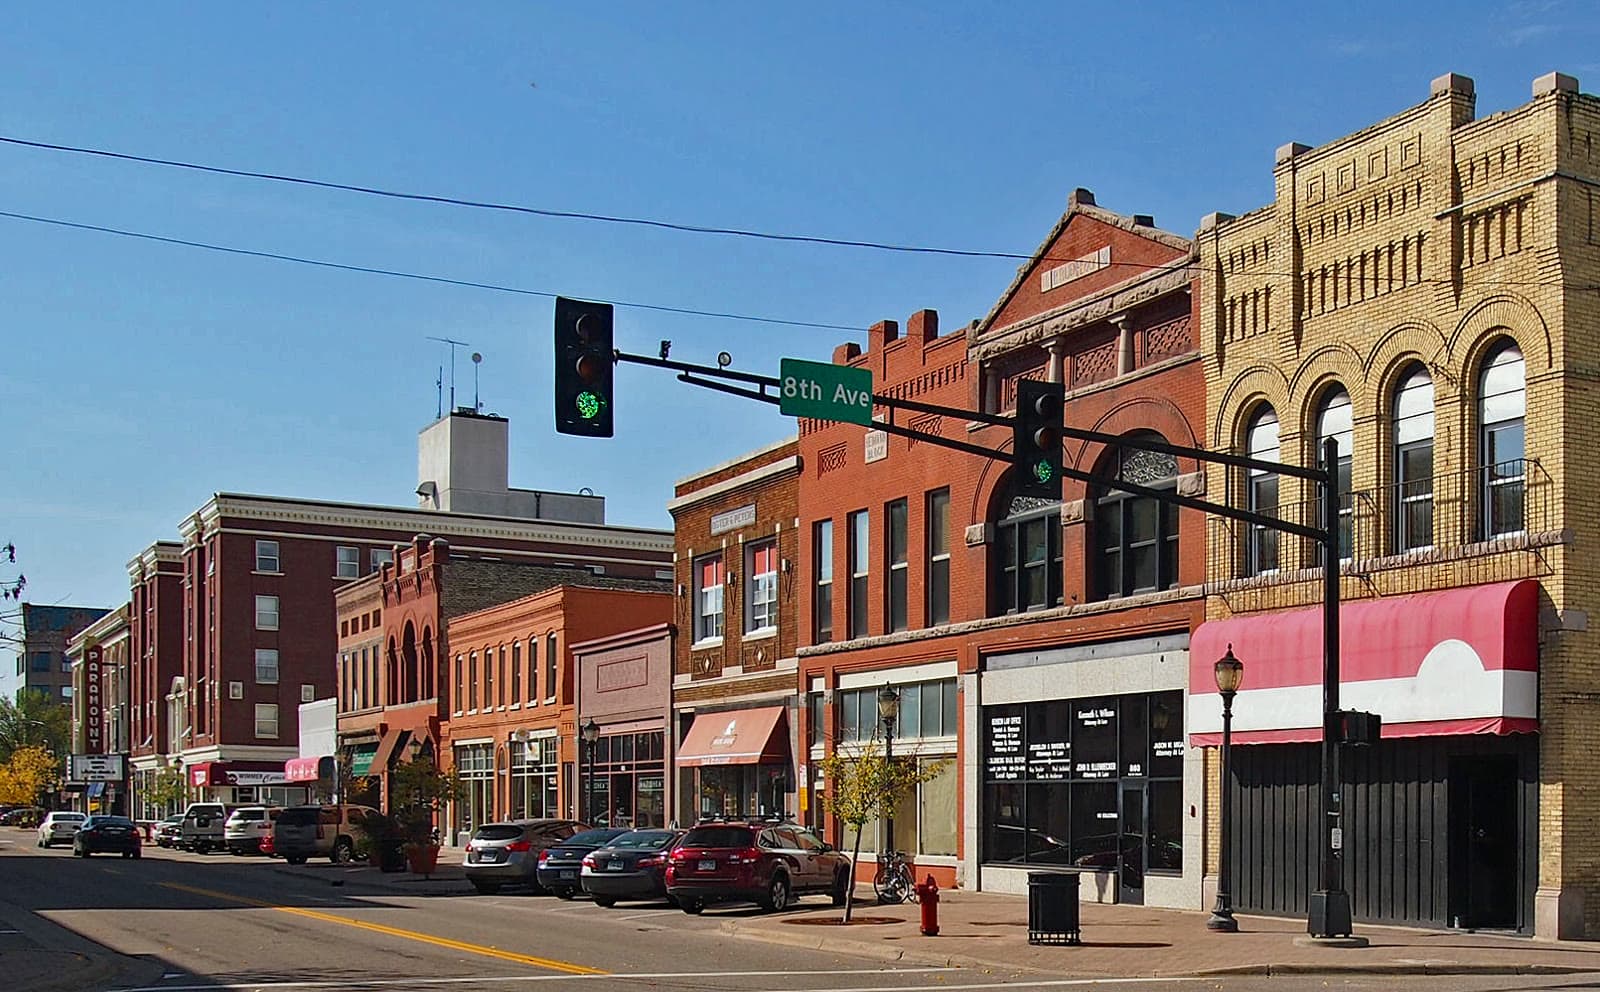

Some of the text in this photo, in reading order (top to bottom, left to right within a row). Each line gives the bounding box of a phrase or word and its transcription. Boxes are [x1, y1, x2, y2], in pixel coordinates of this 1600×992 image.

[783, 376, 870, 407] 8th Ave
[89, 651, 99, 748] PARAMOUNT
